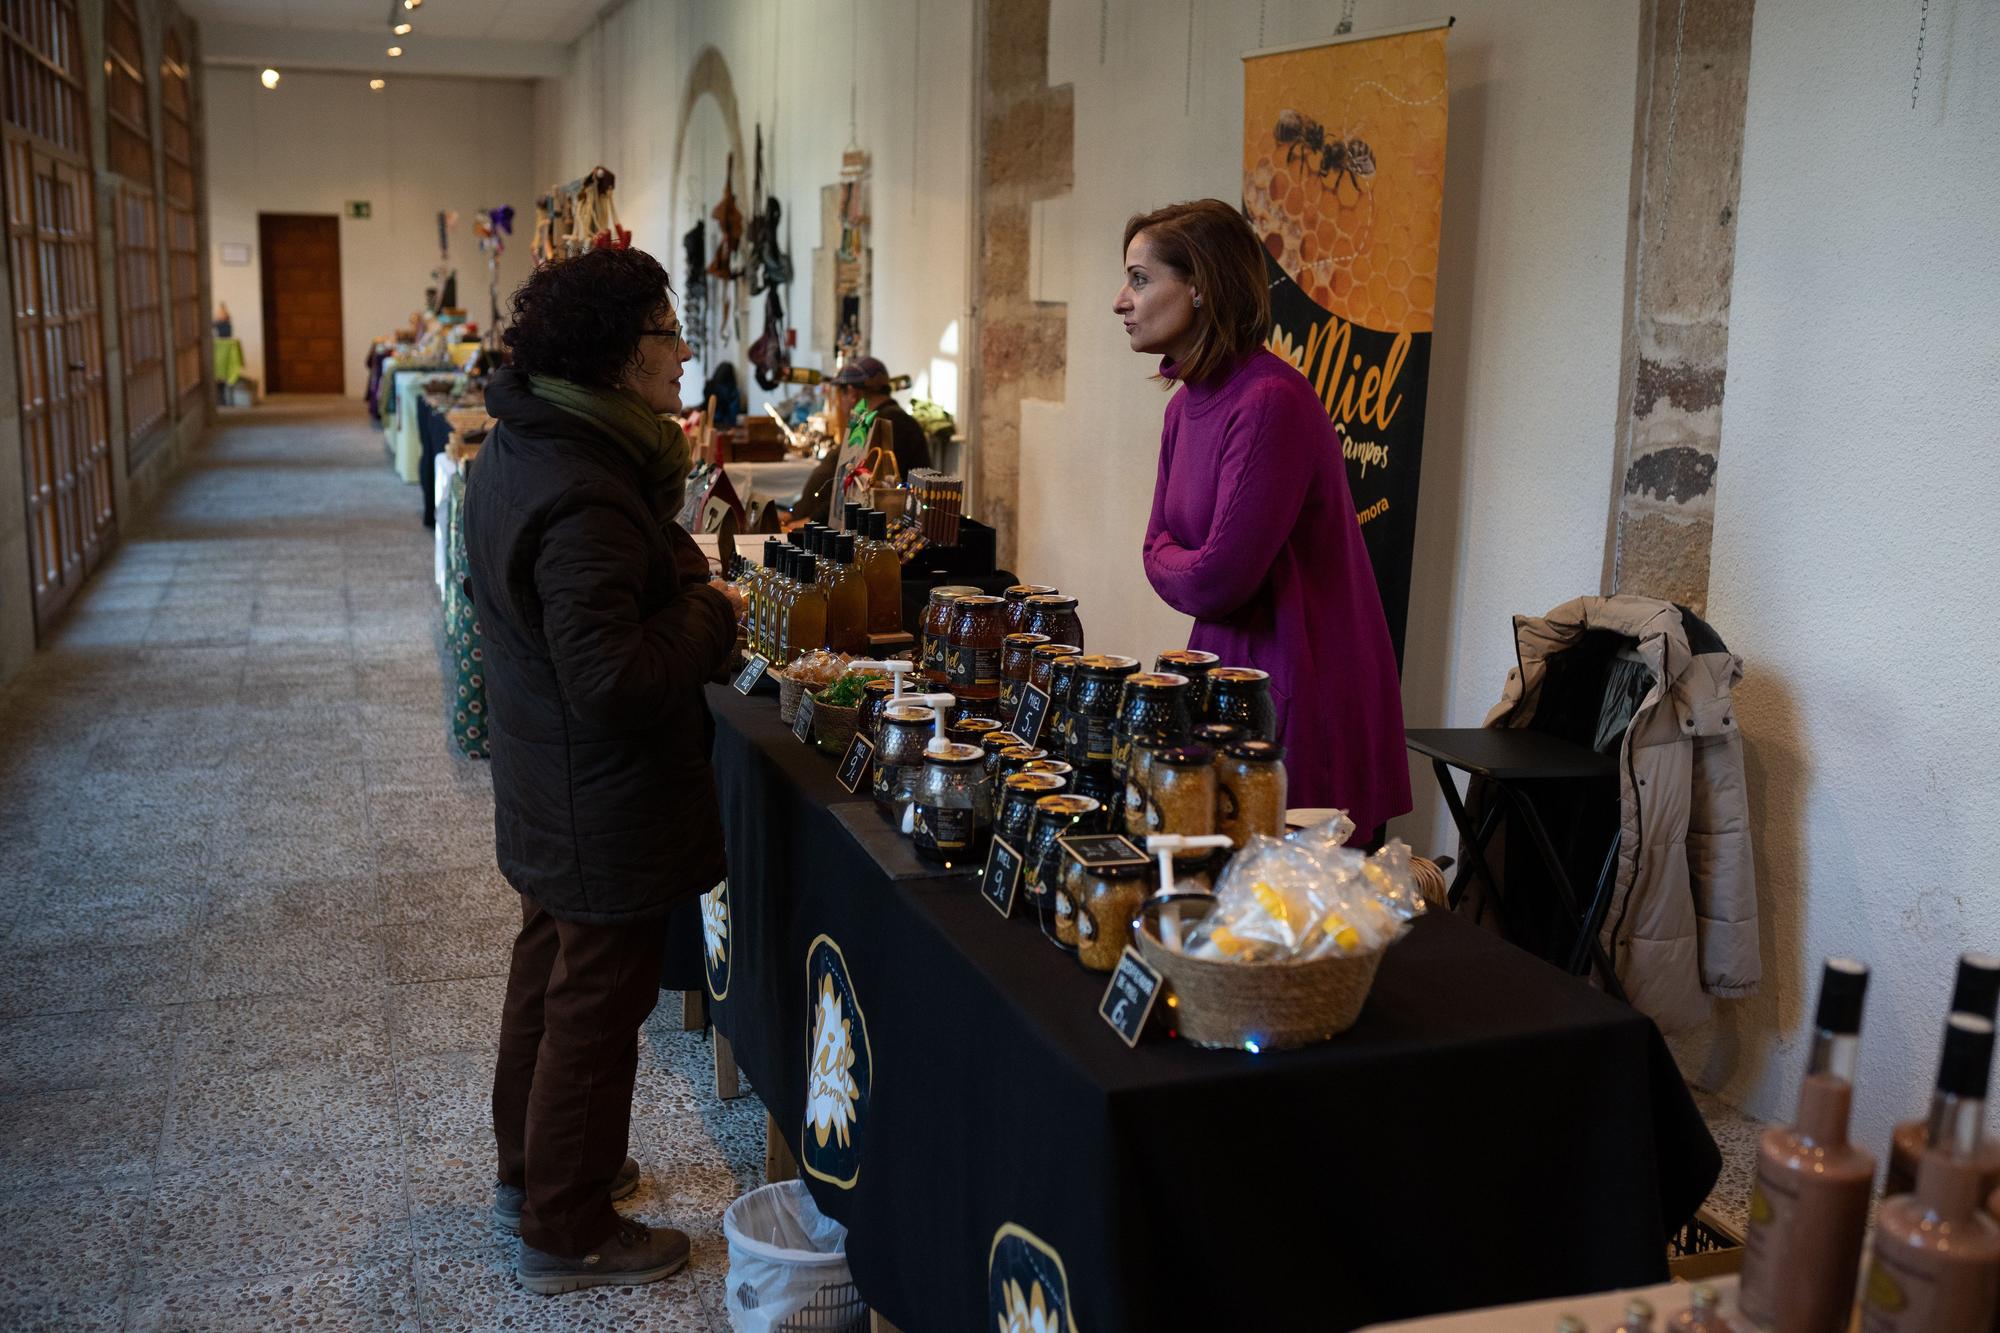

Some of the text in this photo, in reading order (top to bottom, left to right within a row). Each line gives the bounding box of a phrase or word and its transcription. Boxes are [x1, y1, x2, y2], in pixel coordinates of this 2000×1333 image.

[1303, 315, 1412, 431] Miel
[1028, 692, 1041, 711] MIEL
[855, 741, 866, 759] MIEL
[997, 847, 1011, 870] MIEL
